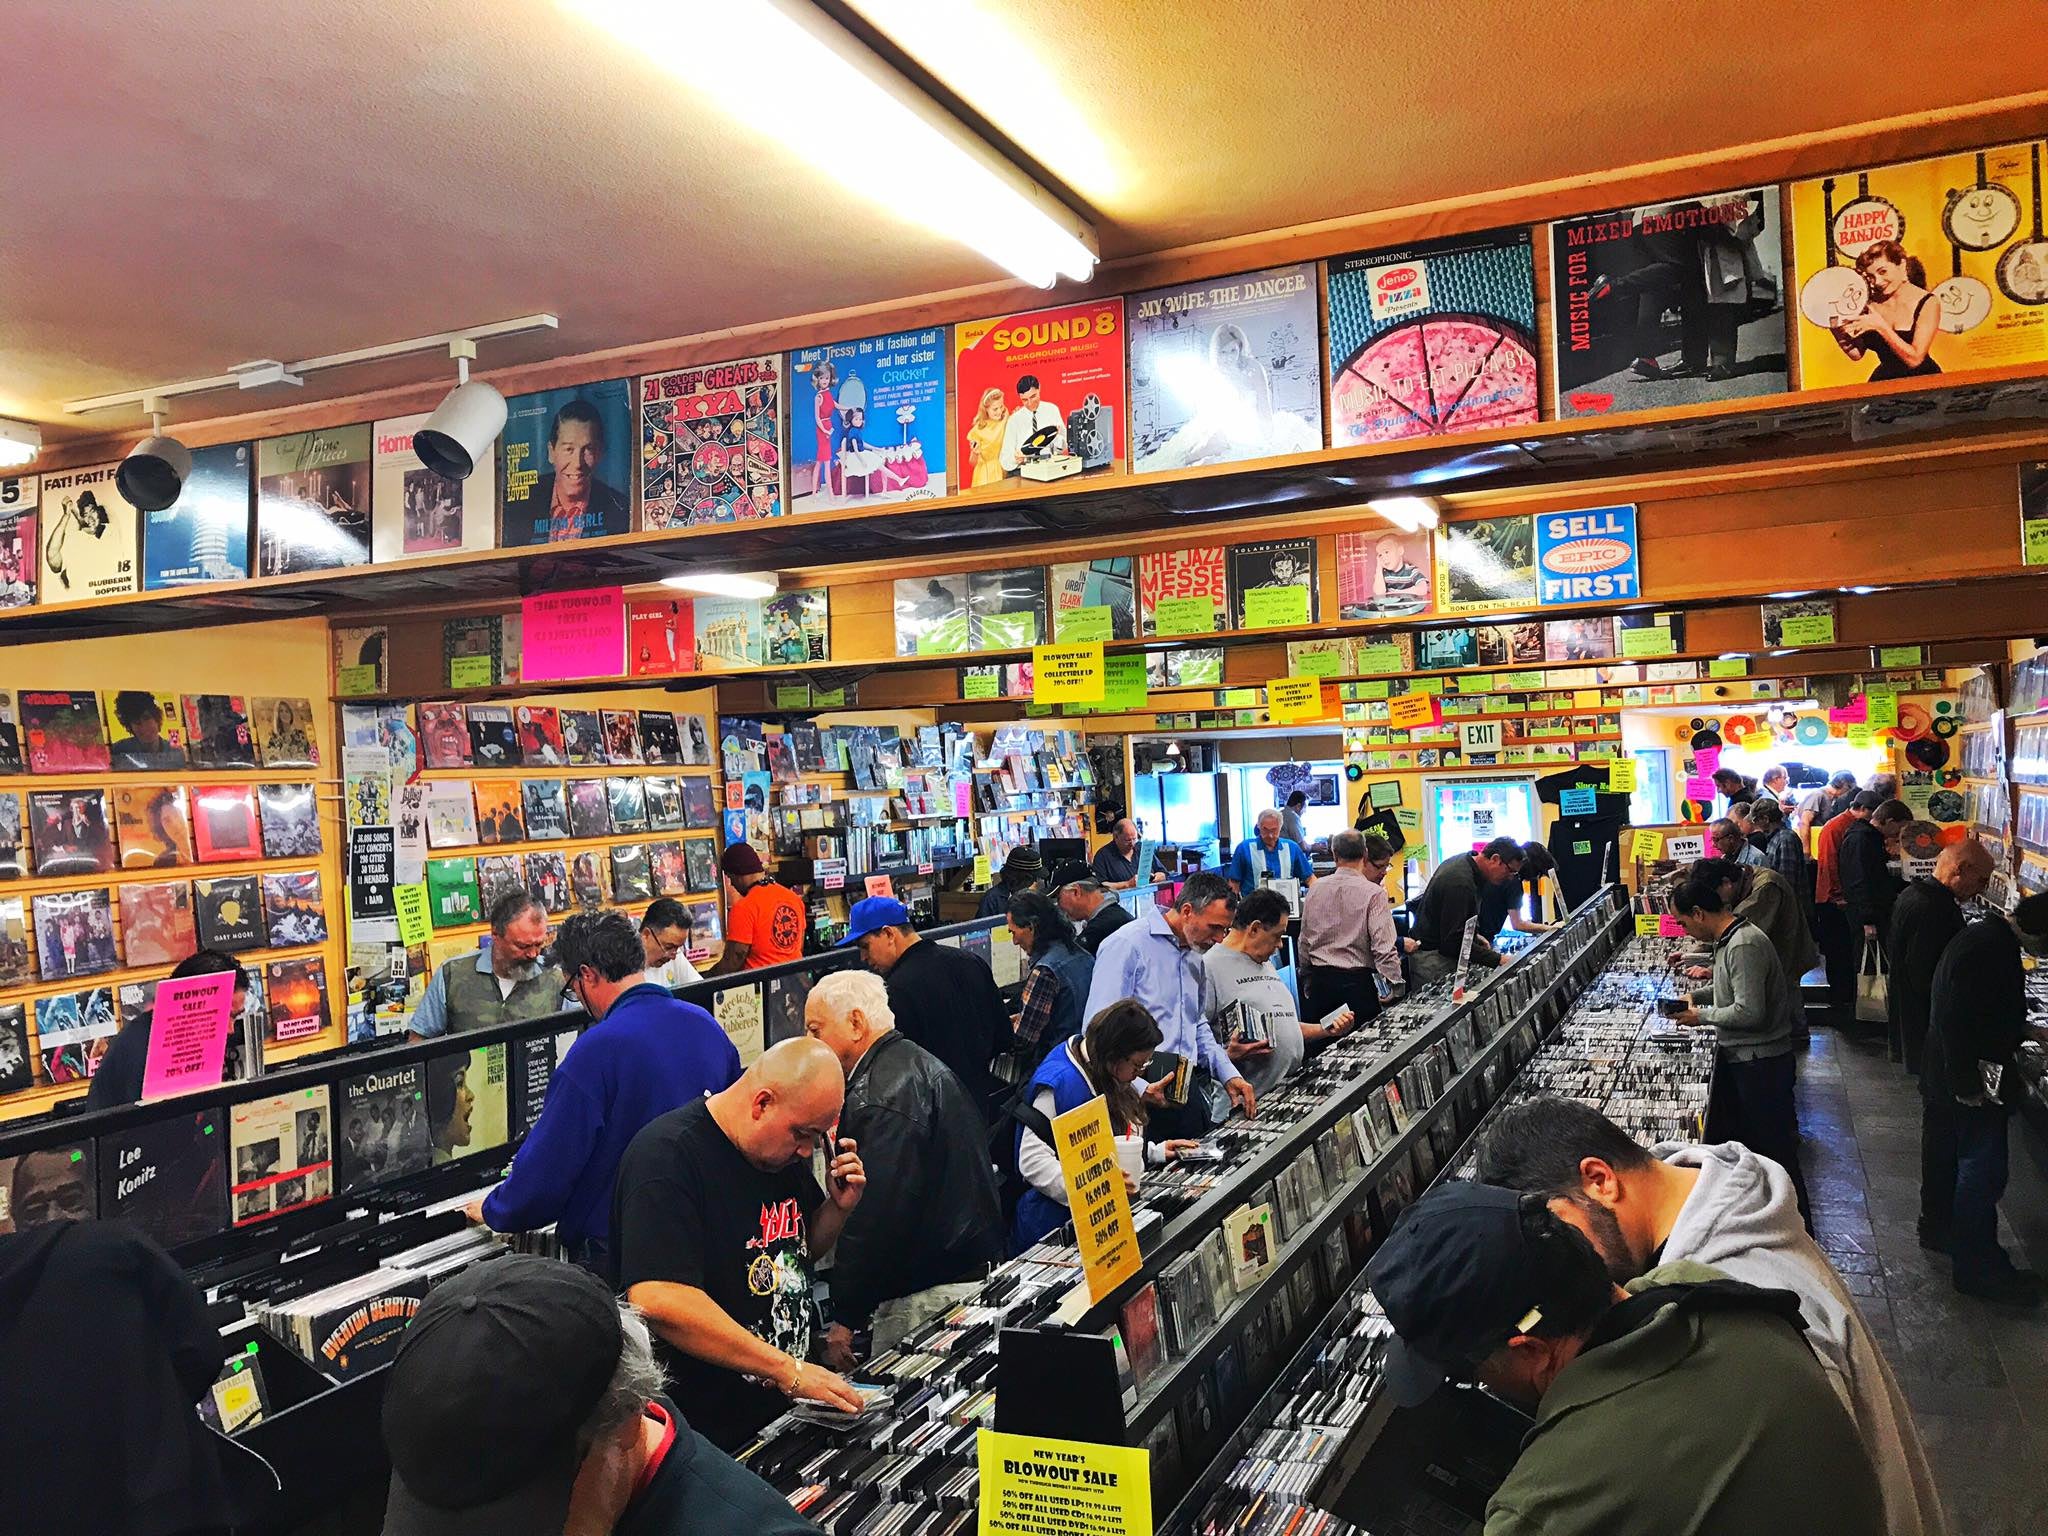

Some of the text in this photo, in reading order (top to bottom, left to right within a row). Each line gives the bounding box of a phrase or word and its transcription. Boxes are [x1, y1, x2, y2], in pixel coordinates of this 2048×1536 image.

[1567, 201, 1748, 247] MIXED EMOTIONS
[1843, 208, 1890, 230] HAPPY
[1839, 224, 1893, 246] BANJOS
[1344, 251, 1412, 270] STEREOPHONIC
[1380, 270, 1415, 289] Jeno's
[1138, 299, 1163, 318] MY
[1209, 285, 1240, 306] THE
[1244, 274, 1307, 299] DANCER
[1568, 251, 1591, 352] MUSIC FOR
[1385, 301, 1418, 314] Presents
[993, 312, 1116, 352] SOUND 8
[801, 349, 821, 362] Meet
[859, 341, 872, 354] the
[876, 339, 884, 351] Hi
[888, 335, 917, 349] fashion
[921, 331, 935, 345] doll
[1006, 342, 1099, 362] BACKGROUND MUSIC
[876, 350, 935, 368] and her sister
[644, 362, 759, 402] 21 GOLDEN GREATS
[664, 382, 696, 397] GATE
[1339, 348, 1527, 412] MUSIC TO EAT PIZZA BY
[674, 390, 744, 421] KYA
[507, 442, 529, 458] SONGS
[44, 474, 72, 491] FAT!
[75, 470, 103, 487] FAT!
[507, 470, 538, 487] MOTHER
[507, 485, 529, 502] LOVED
[1548, 513, 1625, 540] SELL
[1140, 546, 1224, 573] THE JAZZ
[1558, 549, 1617, 564] EPIC
[1079, 570, 1087, 581] IN
[1141, 564, 1224, 593] MESSE
[1065, 579, 1086, 593] ORBIT
[1545, 574, 1632, 600] FIRST
[1059, 592, 1082, 606] CLARK
[632, 613, 647, 621] PLAY
[1043, 653, 1074, 661] BLOWOUT
[1044, 670, 1084, 678] COLLECTIBLE
[1467, 724, 1495, 745] EXIT
[373, 833, 390, 843] SONGS
[366, 843, 392, 853] CONCERTS
[369, 853, 386, 863] CITIES
[368, 864, 385, 874] YEARS
[363, 874, 389, 884] MEMBERS
[368, 895, 383, 905] BAND
[173, 986, 219, 1001] BLOWOUT
[348, 1068, 416, 1098] the Quartet
[1069, 1119, 1100, 1147] BLOWOUT
[119, 1147, 141, 1169] Lee
[1081, 1142, 1098, 1163] SALE!
[118, 1165, 156, 1200] Konitz
[1075, 1172, 1086, 1191] ALL
[1087, 1162, 1101, 1183] USED
[1102, 1180, 1111, 1195] OR
[1090, 1199, 1116, 1227] LESS ARE
[1108, 1219, 1119, 1237] OFF
[1034, 1450, 1085, 1464] NEW YEAR'S
[1004, 1460, 1118, 1487] BLOWOUT SALE
[1003, 1490, 1017, 1498] 50%
[1019, 1491, 1033, 1500] OFF
[1035, 1494, 1048, 1503] ALL
[1050, 1496, 1070, 1506] USED
[1107, 1505, 1122, 1513] LESS
[1000, 1510, 1015, 1519] 50%
[1016, 1513, 1030, 1522] OFF
[1032, 1515, 1046, 1524] ALL
[1047, 1517, 1068, 1527] USED
[1003, 1500, 1017, 1509] 50%
[1019, 1502, 1033, 1511] OFF
[1035, 1505, 1048, 1514] ALL
[1050, 1507, 1070, 1517] USED
[1108, 1516, 1122, 1524] LESS
[989, 1520, 1057, 1536] 50% OFF ALL USED
